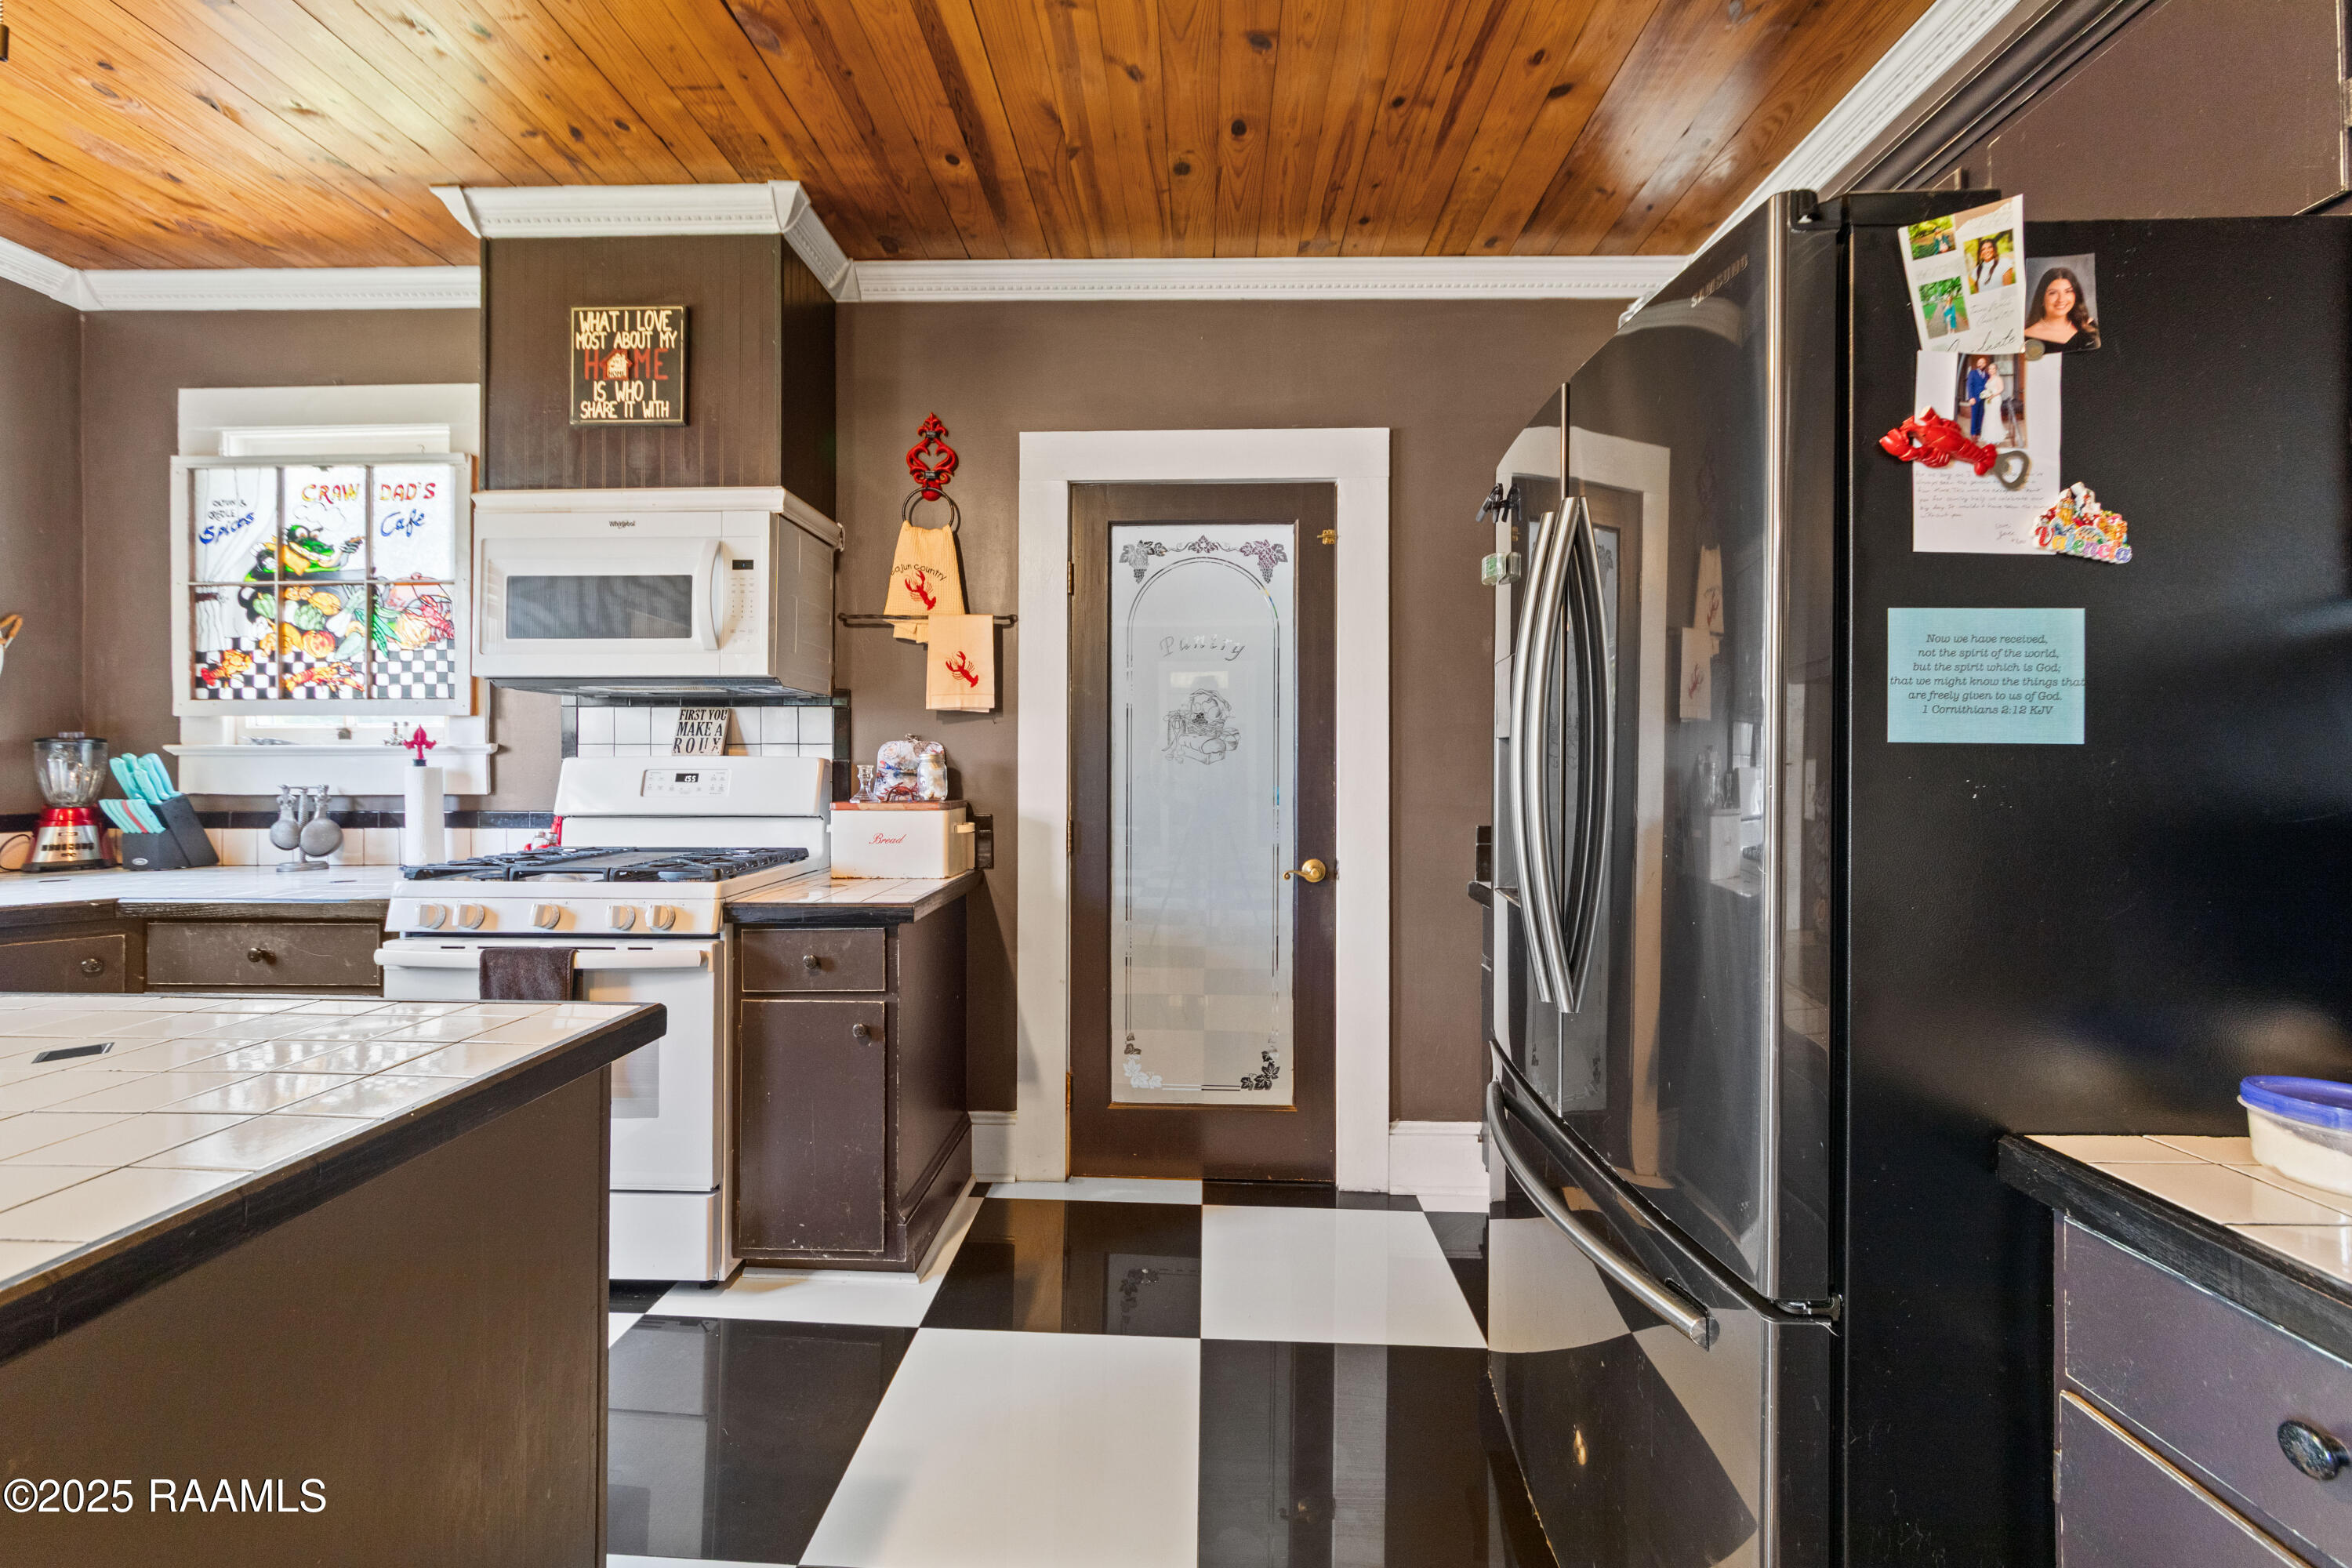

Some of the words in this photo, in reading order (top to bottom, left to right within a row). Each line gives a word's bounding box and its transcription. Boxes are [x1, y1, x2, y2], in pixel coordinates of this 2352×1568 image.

[579, 310, 620, 332] WHAT
[624, 310, 629, 332] I
[637, 310, 673, 332] LOVE
[575, 332, 608, 350] MOST
[613, 331, 653, 350] ABOUT
[659, 330, 677, 349] MY
[593, 380, 607, 402] IS
[615, 380, 644, 402] WHO
[652, 380, 657, 401] I
[580, 401, 618, 419] SHARE
[623, 401, 636, 418] IT
[642, 401, 670, 418] WITH
[302, 483, 360, 504] CRAW
[380, 482, 436, 502] DAD'S
[2034, 526, 2132, 562] Valencia
[1926, 634, 1951, 643] Now
[1971, 634, 1997, 643] have
[1999, 634, 2048, 644] received,
[1939, 648, 1957, 657] the
[1958, 648, 1988, 659] spirit
[1991, 648, 2003, 659] of
[2004, 648, 2022, 657] the
[2024, 648, 2059, 659] world,
[1913, 662, 1932, 671] but
[1934, 662, 1952, 671] the
[1954, 662, 1984, 673] spirit
[1987, 662, 2020, 671] which
[2023, 663, 2033, 672] is
[1890, 677, 1913, 685] that
[1933, 677, 1967, 688] might
[1969, 677, 1999, 686] know
[2002, 677, 2020, 686] the
[2022, 677, 2059, 688] things
[2061, 677, 2085, 687] that
[1927, 691, 1960, 702] freely
[1962, 691, 1993, 702] given
[1995, 691, 2006, 700] to
[2025, 691, 2037, 702] of
[2038, 691, 2063, 701] God.
[679, 709, 706, 720] FIRST
[709, 709, 728, 720] YOU
[1922, 705, 1928, 713] 1
[2001, 706, 2027, 714] 2:12
[2029, 706, 2054, 715] KJV
[677, 721, 713, 736] MAKE
[714, 723, 723, 737] A
[869, 833, 907, 844] Bread
